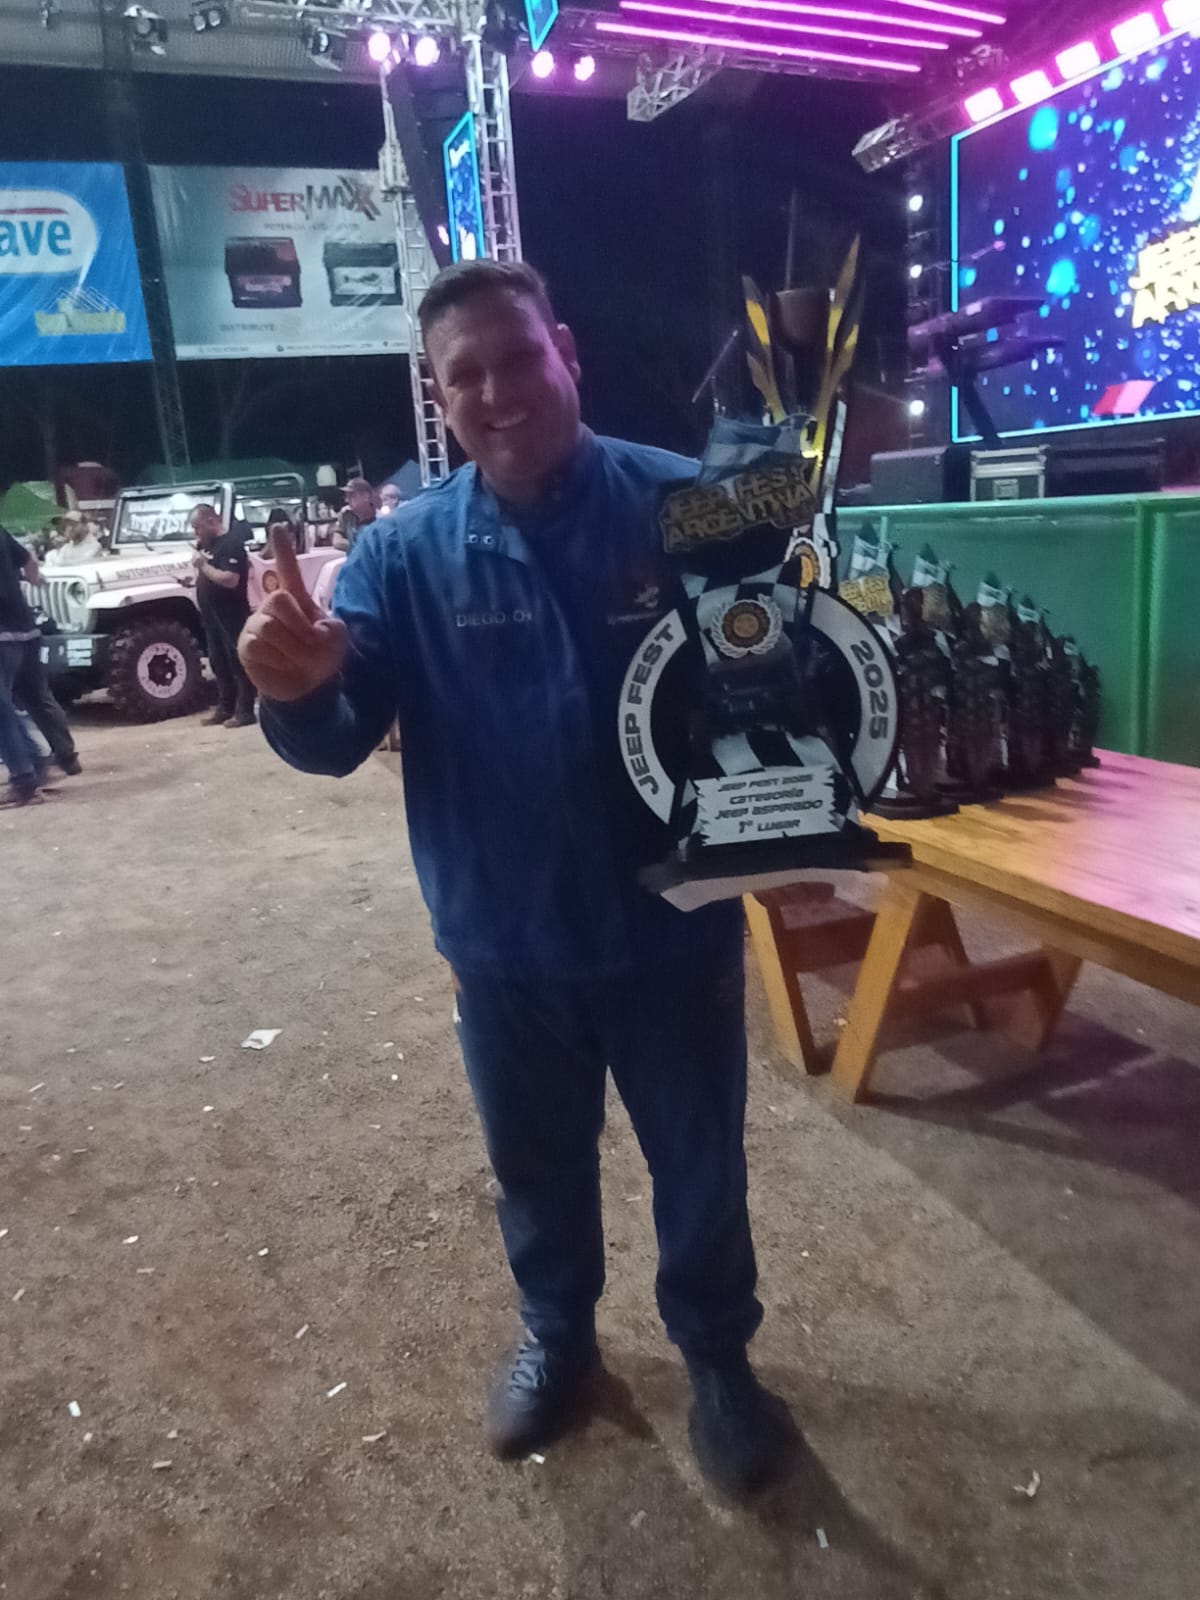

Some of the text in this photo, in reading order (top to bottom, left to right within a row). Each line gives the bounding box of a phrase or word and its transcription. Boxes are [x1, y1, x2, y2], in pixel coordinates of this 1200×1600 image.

[455, 612, 506, 628] DIEGO
[627, 623, 675, 706] FEST
[850, 640, 889, 740] 2025
[624, 712, 660, 796] JEEP
[718, 782, 748, 792] JEEP
[748, 778, 779, 788] FEST
[715, 807, 749, 820] JEEP
